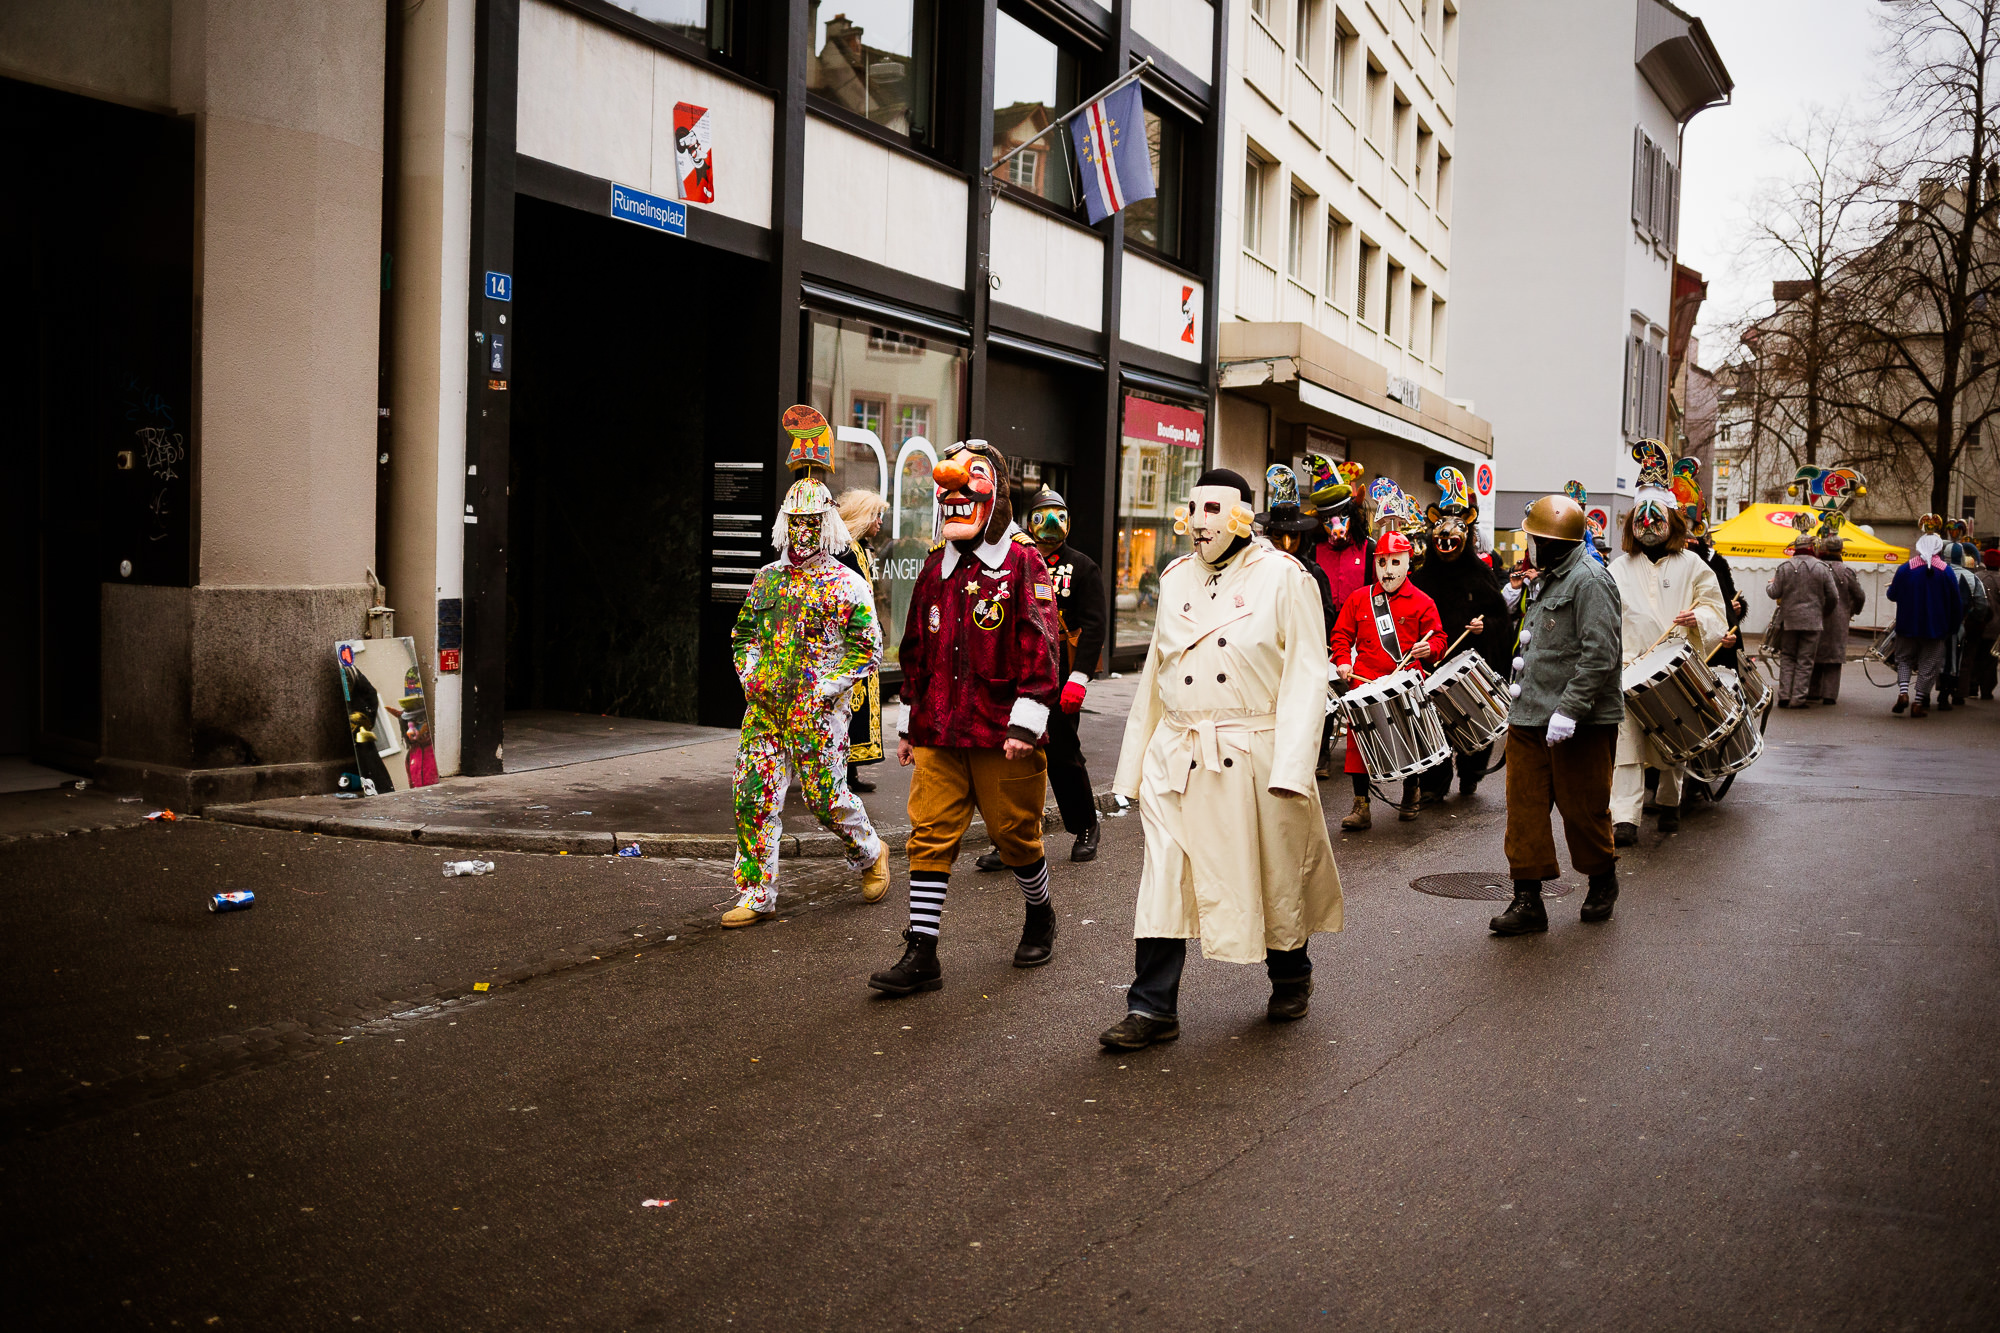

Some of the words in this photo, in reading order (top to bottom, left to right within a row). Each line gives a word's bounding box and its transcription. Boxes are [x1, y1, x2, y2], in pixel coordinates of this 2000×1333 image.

[614, 189, 684, 227] Rümelinsplatz
[491, 276, 506, 296] 14
[1157, 421, 1185, 442] Boutique
[1185, 427, 1201, 446] Dolly
